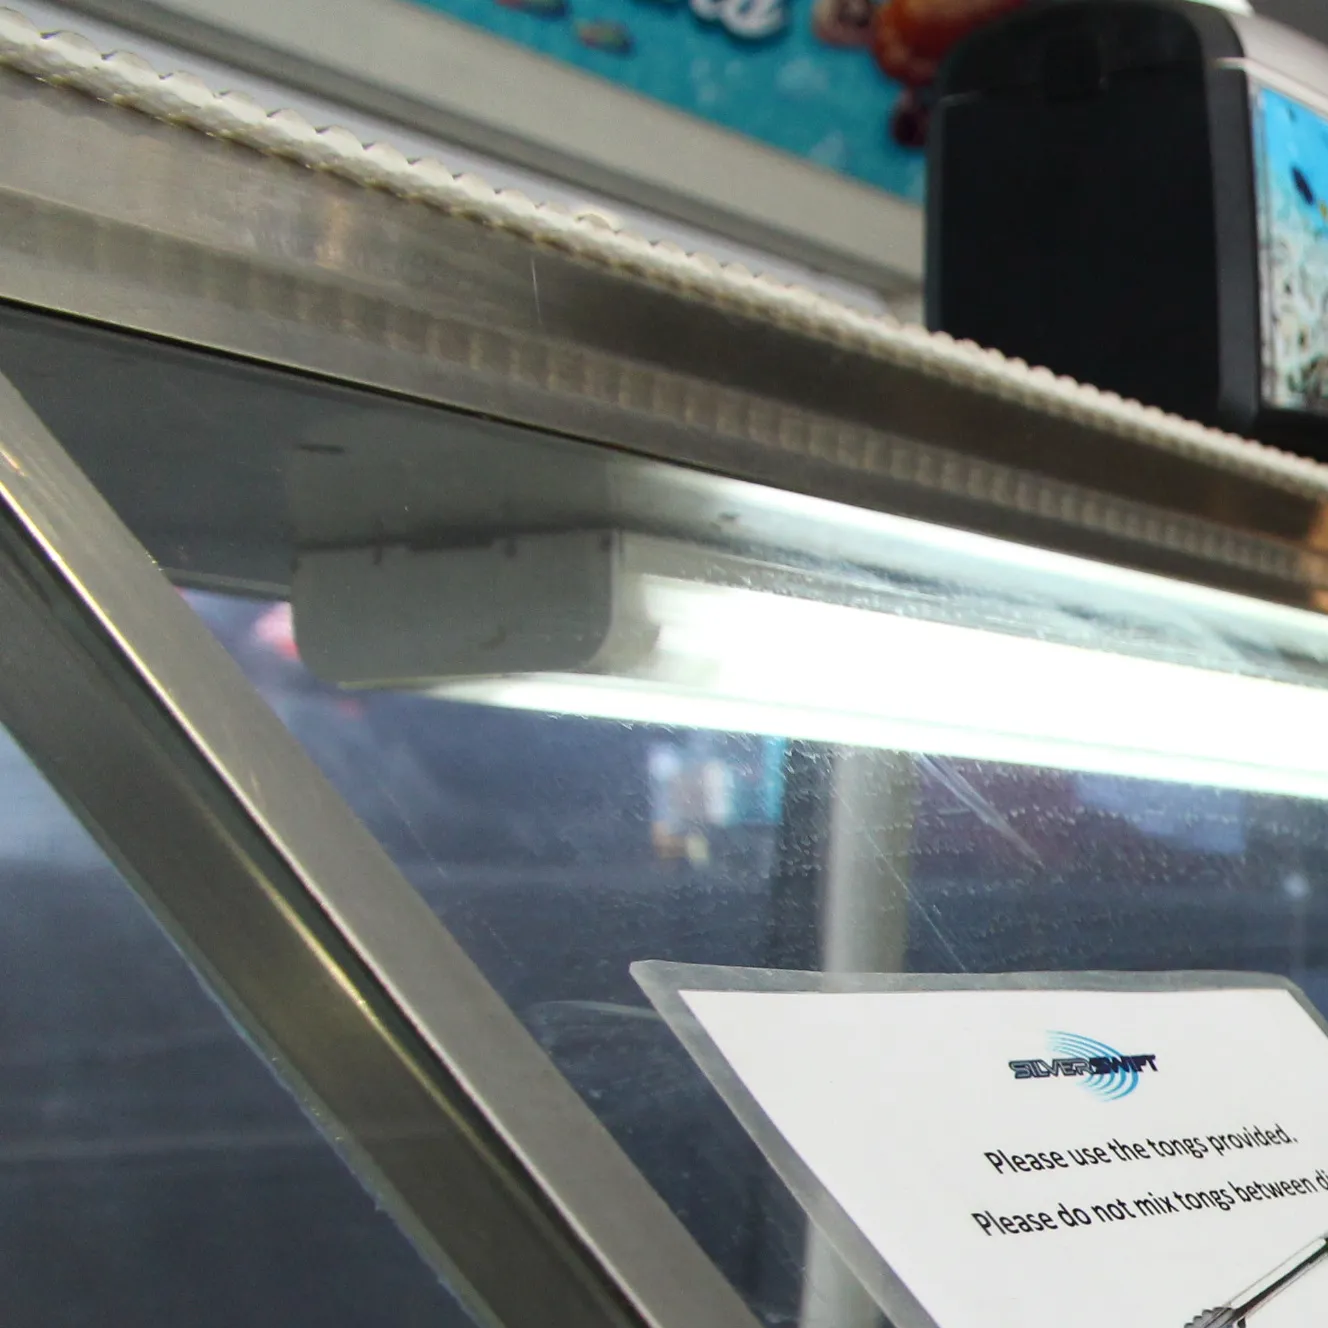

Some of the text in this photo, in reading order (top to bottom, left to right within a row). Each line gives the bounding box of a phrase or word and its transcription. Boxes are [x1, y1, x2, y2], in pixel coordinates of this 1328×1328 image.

[984, 1123, 1298, 1174] Please use the tongs provided.
[971, 1210, 1058, 1236] Please
[1057, 1202, 1092, 1227] do
[1091, 1198, 1136, 1223] not
[1133, 1191, 1180, 1216] mix
[1173, 1188, 1236, 1211] tongs
[1227, 1181, 1318, 1202] between
